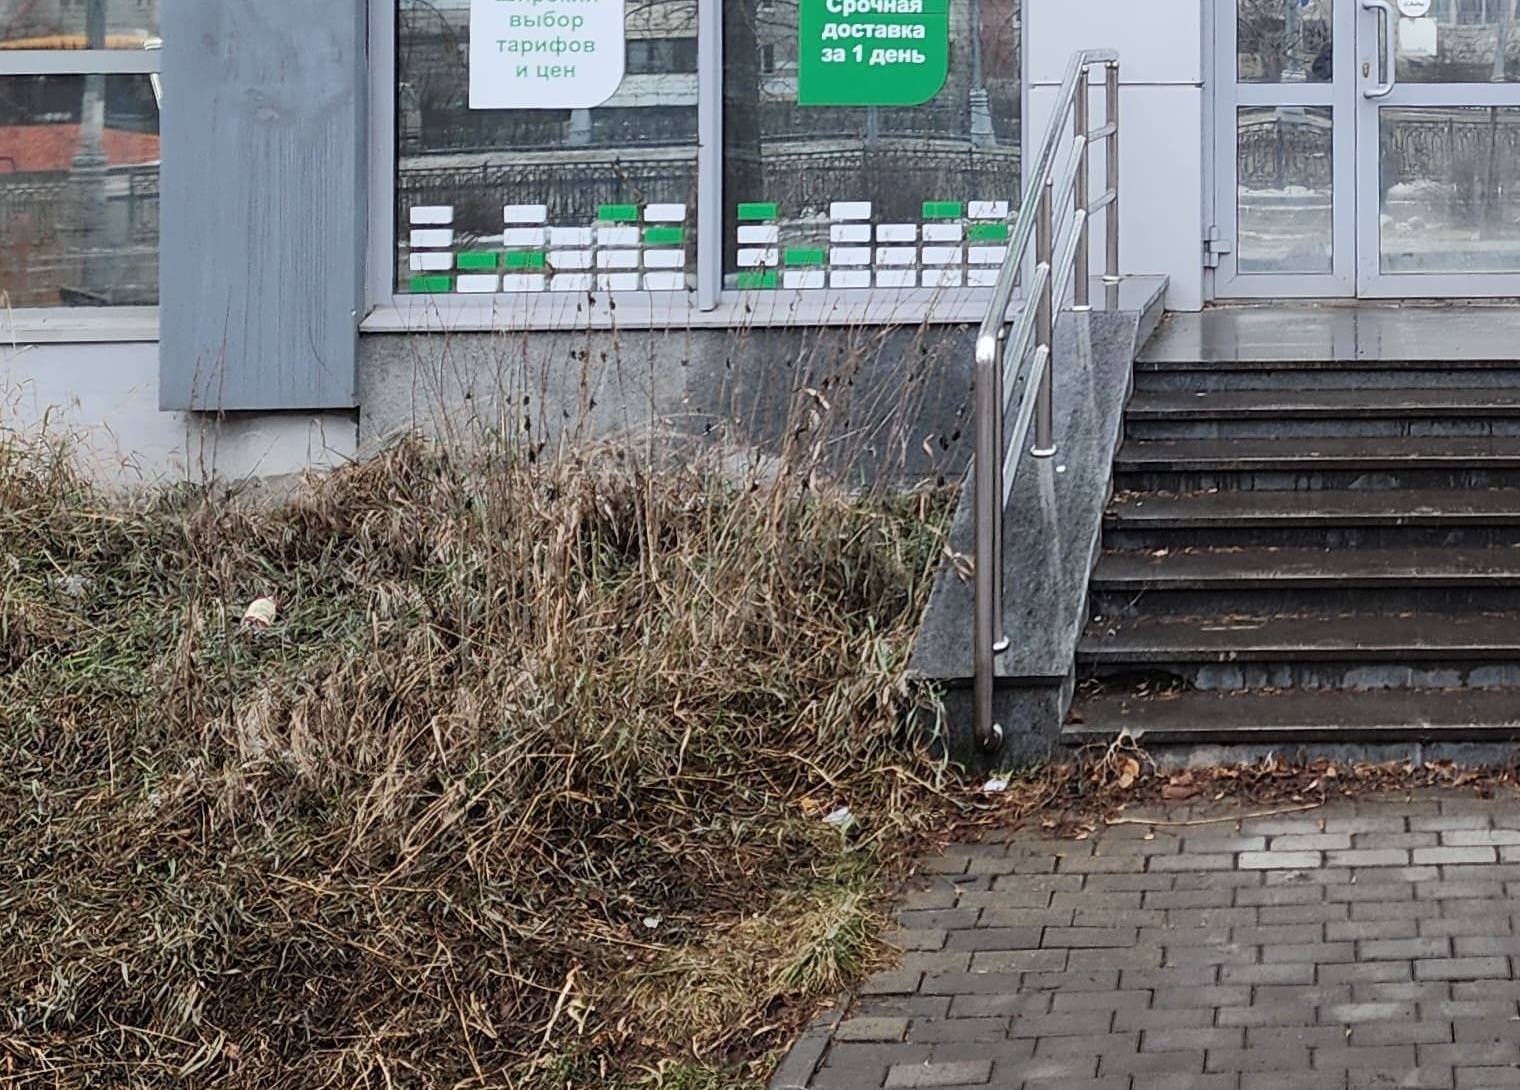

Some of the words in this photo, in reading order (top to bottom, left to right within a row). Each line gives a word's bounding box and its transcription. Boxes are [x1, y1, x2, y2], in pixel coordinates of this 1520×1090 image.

[509, 11, 584, 31] выбор
[821, 23, 926, 40] доставка
[496, 36, 596, 57] тарифов
[820, 47, 846, 63] за
[852, 44, 864, 62] 1
[868, 48, 926, 66] день
[516, 65, 528, 78] и
[536, 65, 576, 81] цен
